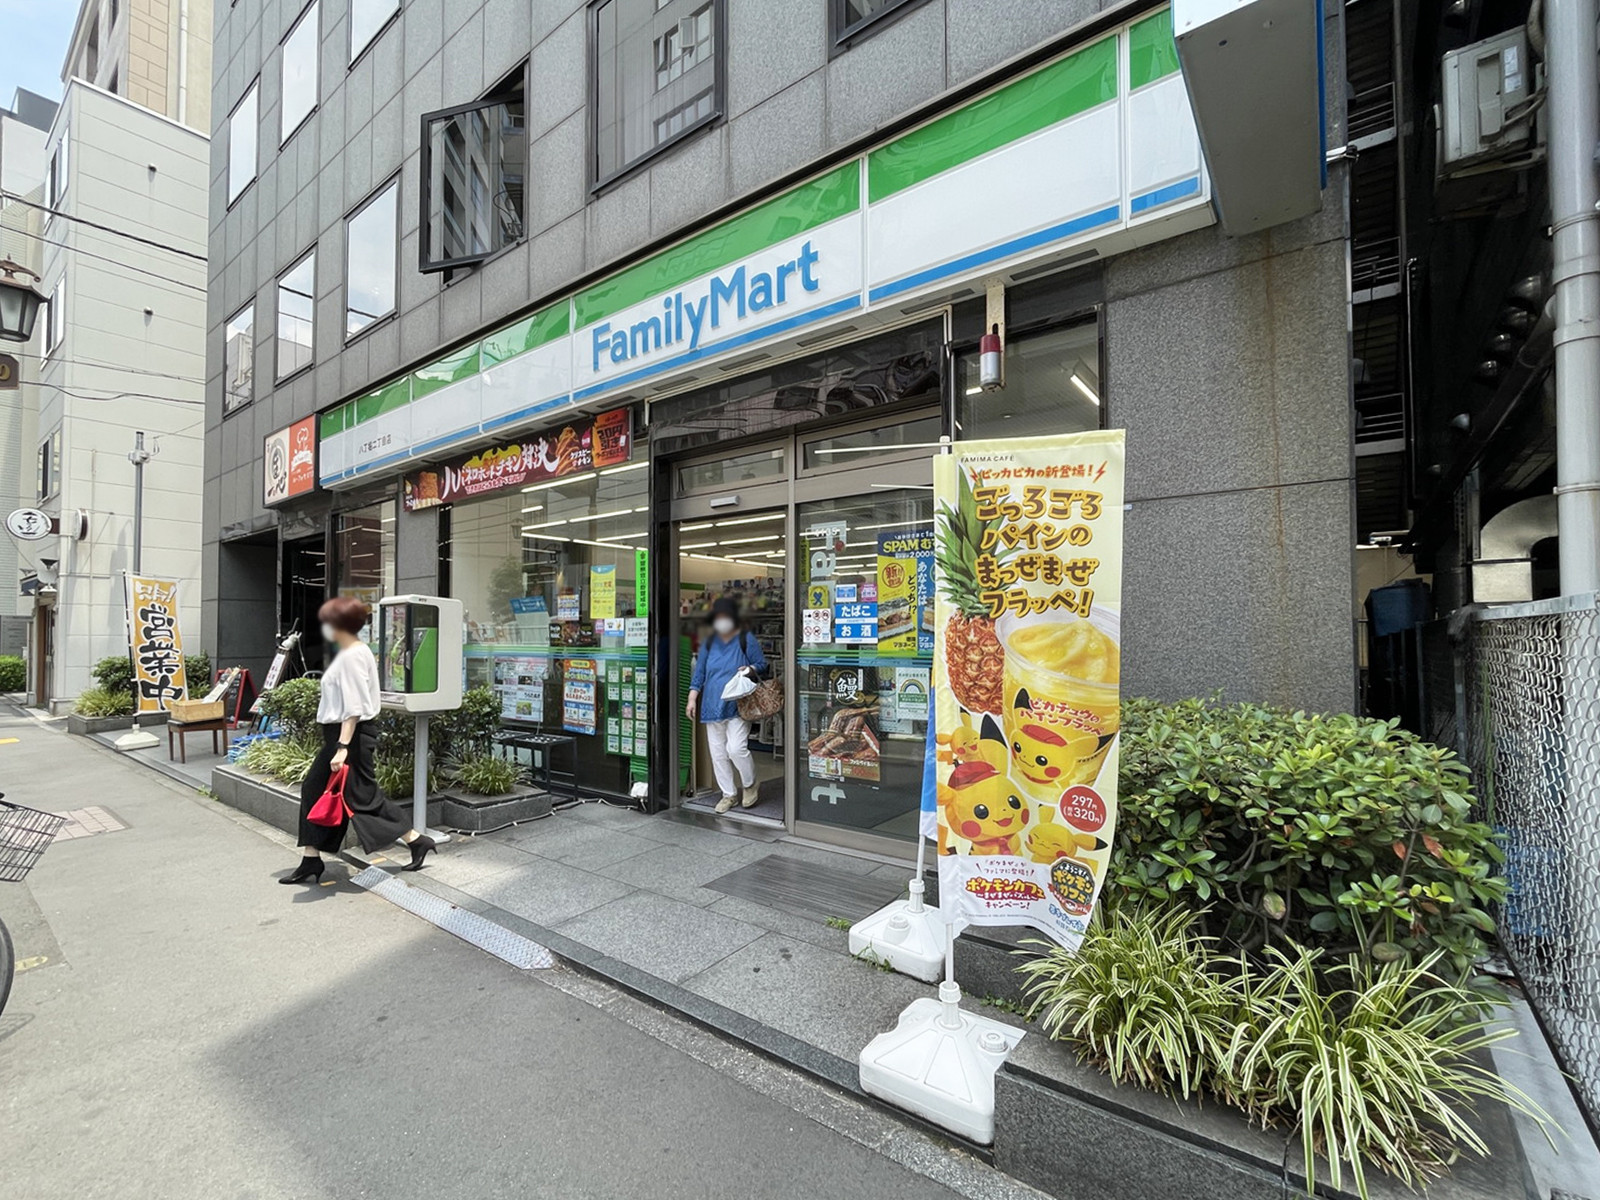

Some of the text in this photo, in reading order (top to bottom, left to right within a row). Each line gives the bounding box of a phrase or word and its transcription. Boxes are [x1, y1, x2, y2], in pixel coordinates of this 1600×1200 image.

[593, 240, 819, 371] FamilyMart
[960, 456, 991, 464] FAMIMA
[975, 485, 1102, 520] ごっろごろ
[981, 523, 1091, 549] パインの
[975, 555, 1099, 586] まっぜまぜ
[917, 561, 928, 606] あなたは
[841, 605, 871, 617] たばこ
[980, 589, 1093, 617] フラッペ!
[140, 603, 183, 710] 営業中
[836, 677, 858, 700] 鰻
[1029, 698, 1101, 723] ピカチュウの
[1020, 710, 1105, 737] パインフラッペ
[966, 878, 1046, 899] ポケモンカフェ
[1053, 869, 1093, 894] ポケモン
[1059, 884, 1087, 903] カフェ
[985, 901, 1030, 910] キャンペーン!
